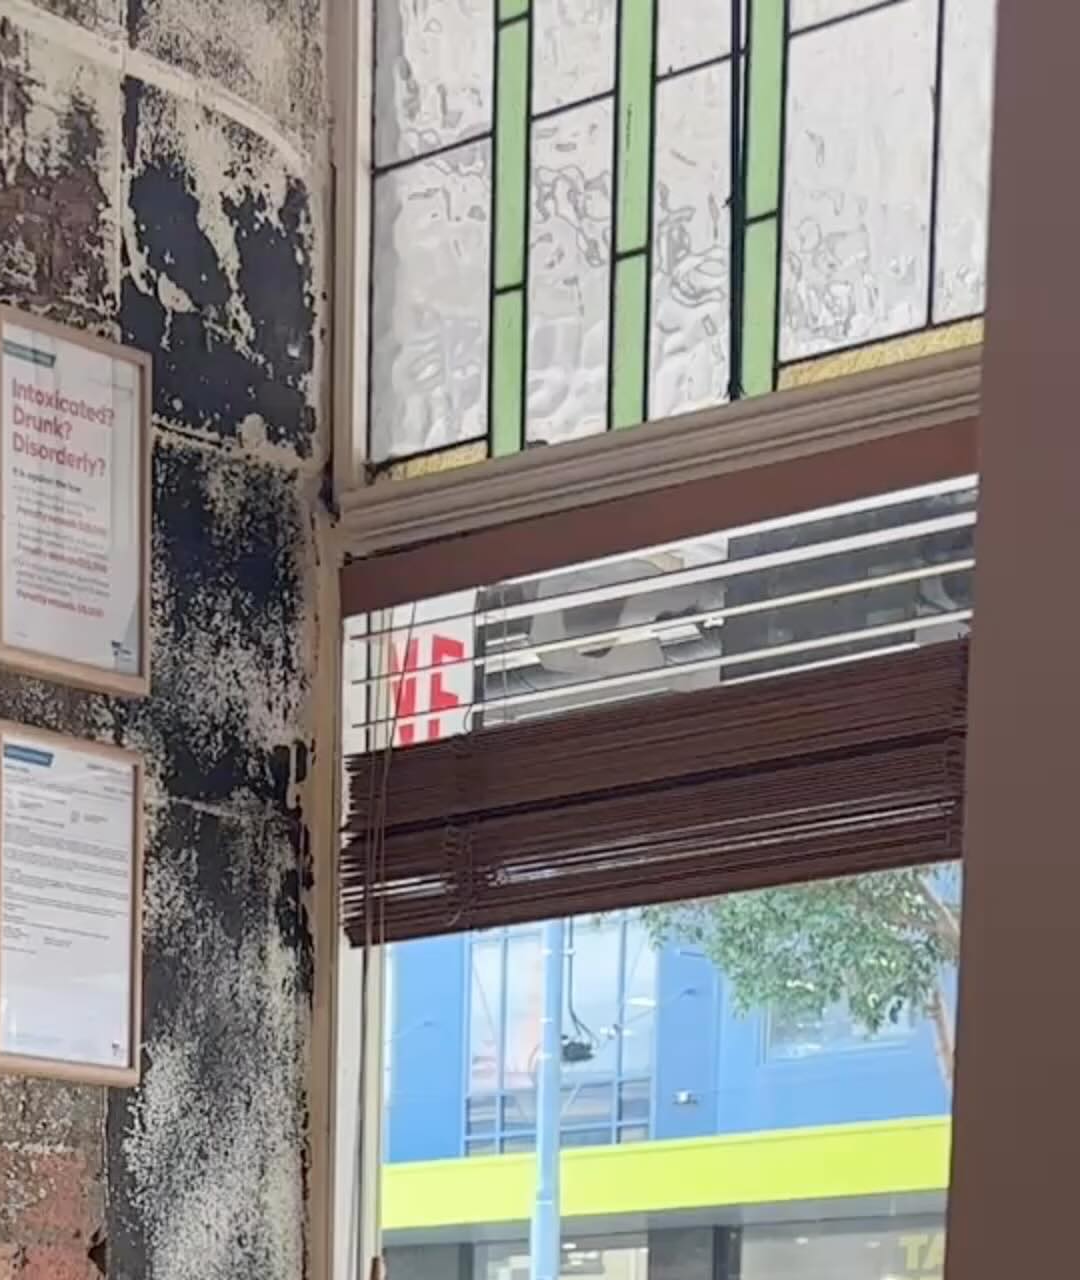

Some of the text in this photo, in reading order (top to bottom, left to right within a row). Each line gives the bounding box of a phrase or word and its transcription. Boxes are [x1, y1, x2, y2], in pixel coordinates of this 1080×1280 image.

[12, 378, 115, 427] Intoxicated?
[13, 405, 73, 440] Drunk?
[12, 432, 107, 477] Disorderly?
